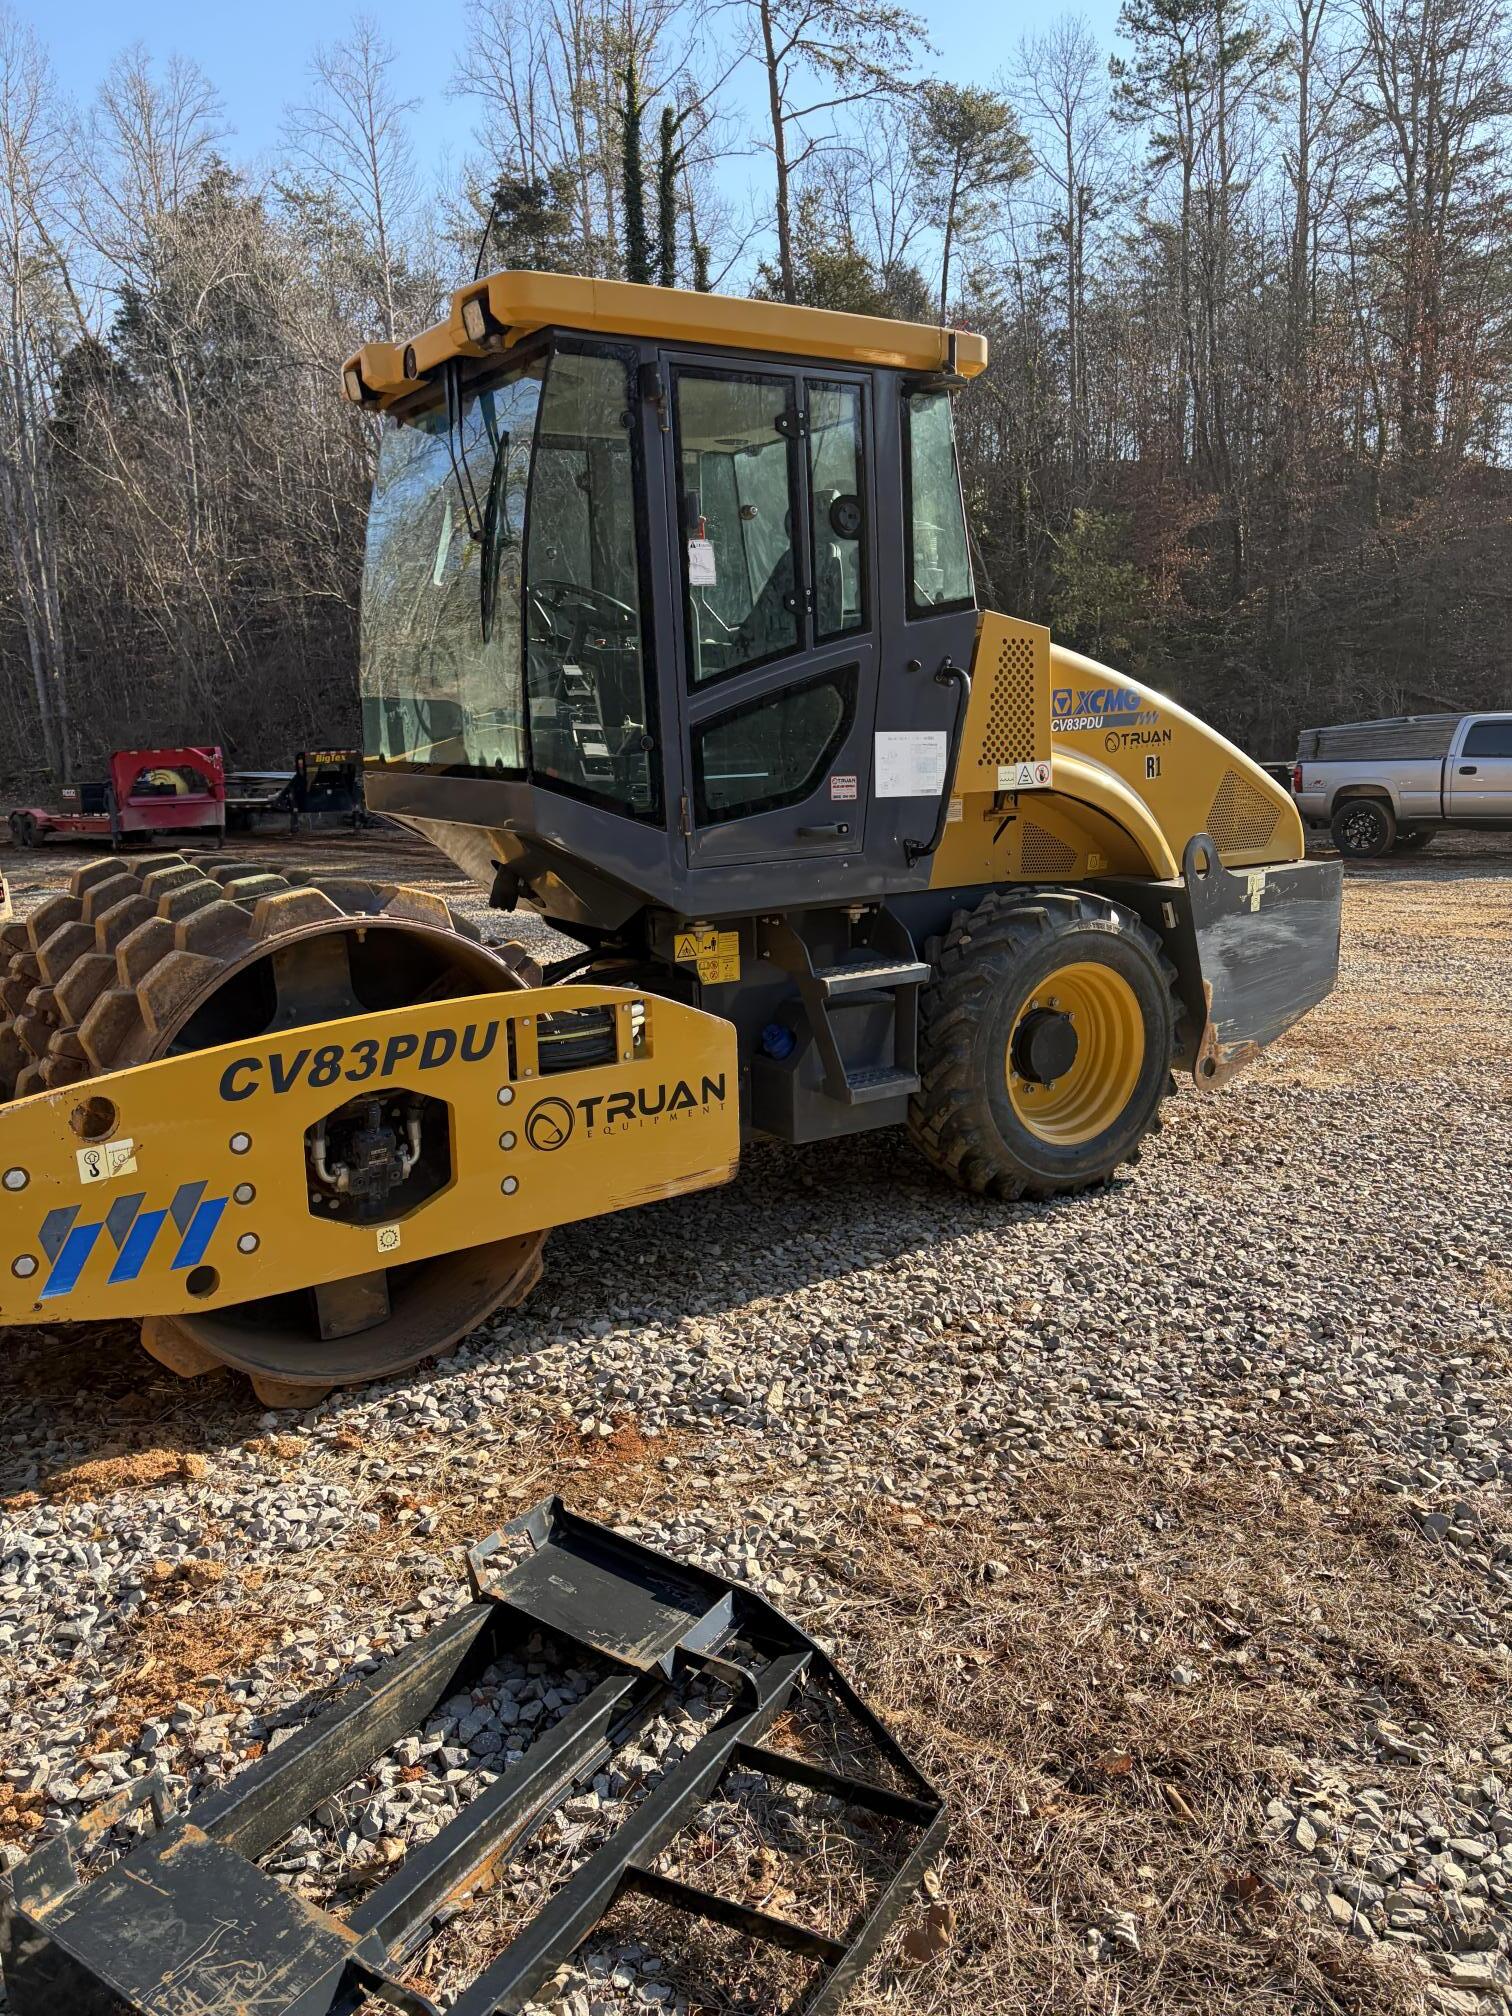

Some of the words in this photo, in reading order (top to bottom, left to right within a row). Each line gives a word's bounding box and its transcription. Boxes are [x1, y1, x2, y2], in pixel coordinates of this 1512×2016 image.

[1074, 688, 1141, 715] XCMG
[1051, 716, 1104, 732] CV83PDU
[1121, 729, 1172, 747] TRUAN
[1146, 755, 1162, 779] R1
[219, 1020, 500, 1102] CV83PDU
[576, 1073, 726, 1128] TRUAN
[586, 1102, 726, 1139] EQUIPMENT
